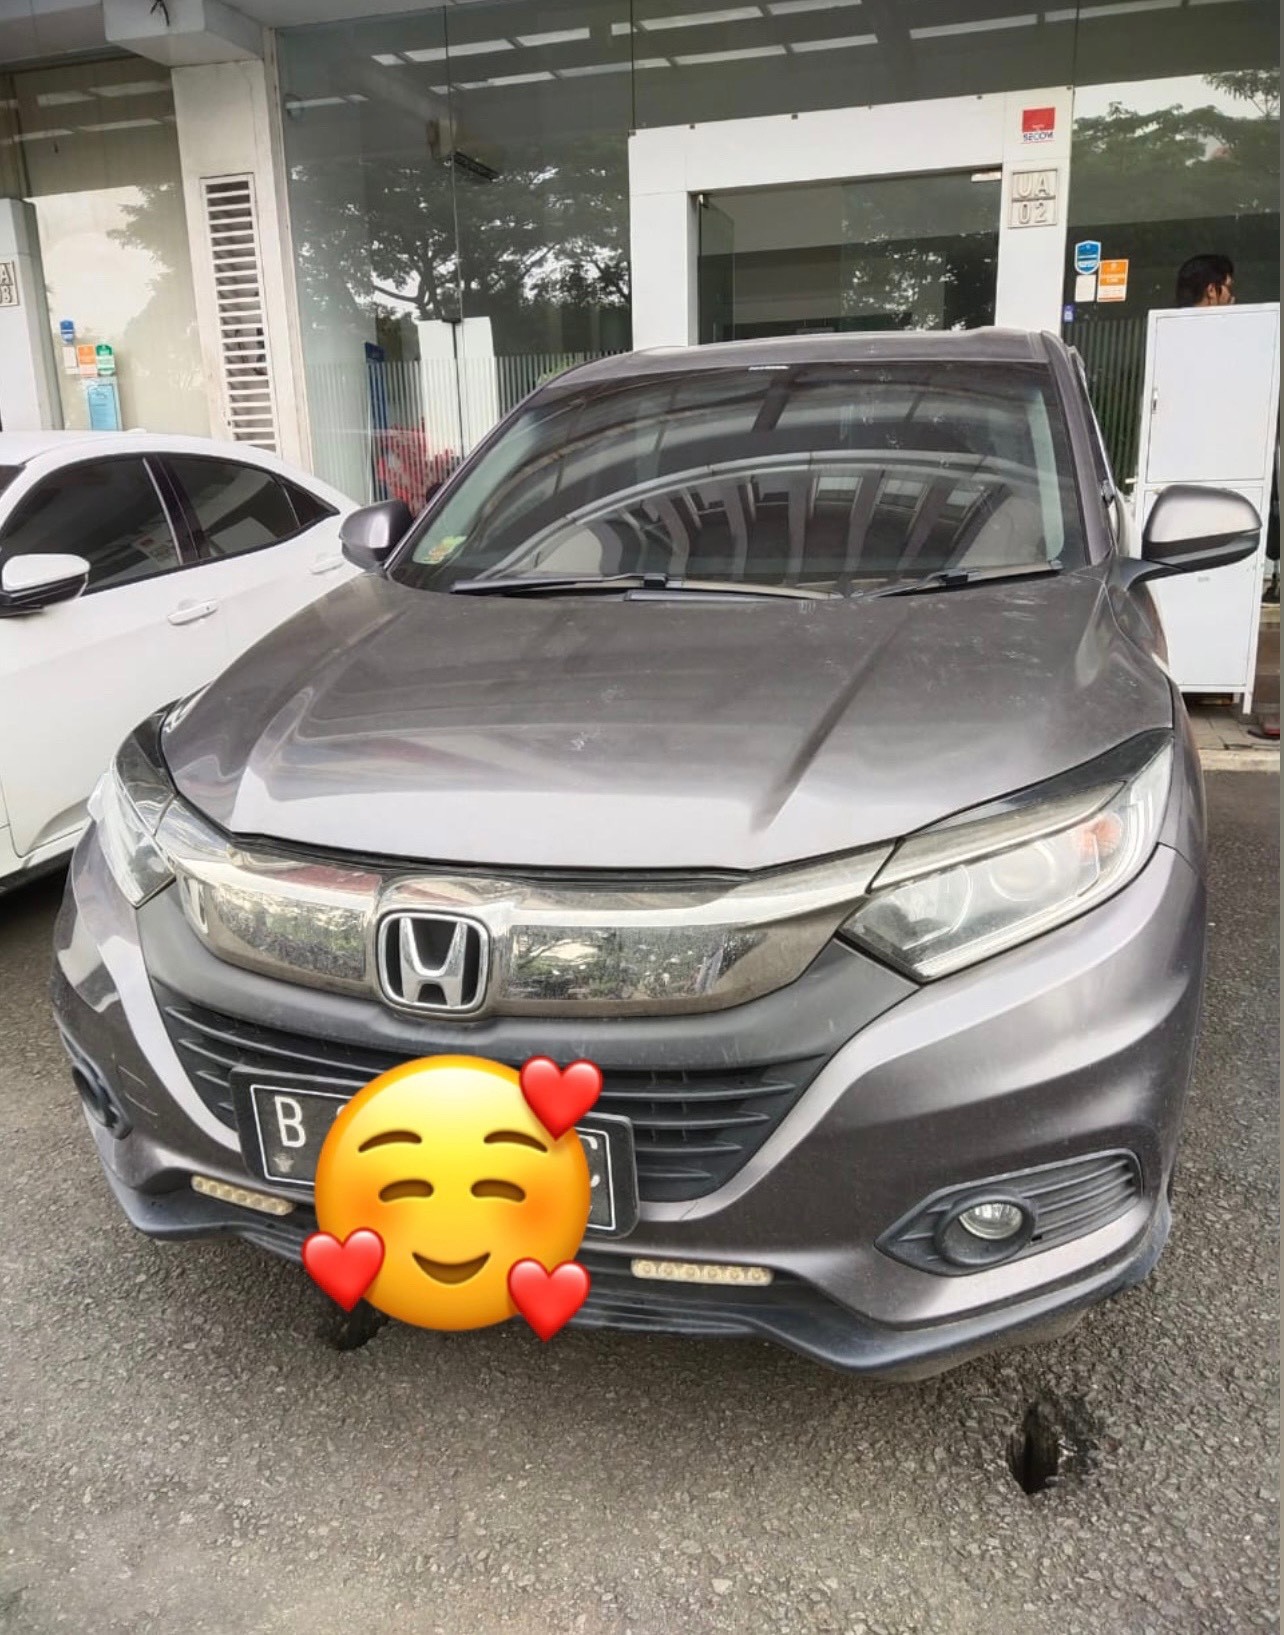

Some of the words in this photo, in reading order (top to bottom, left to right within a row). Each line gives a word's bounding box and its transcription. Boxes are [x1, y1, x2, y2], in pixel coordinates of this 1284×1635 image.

[1017, 174, 1051, 198] UA
[1018, 201, 1047, 224] 02
[275, 1095, 306, 1148] B
